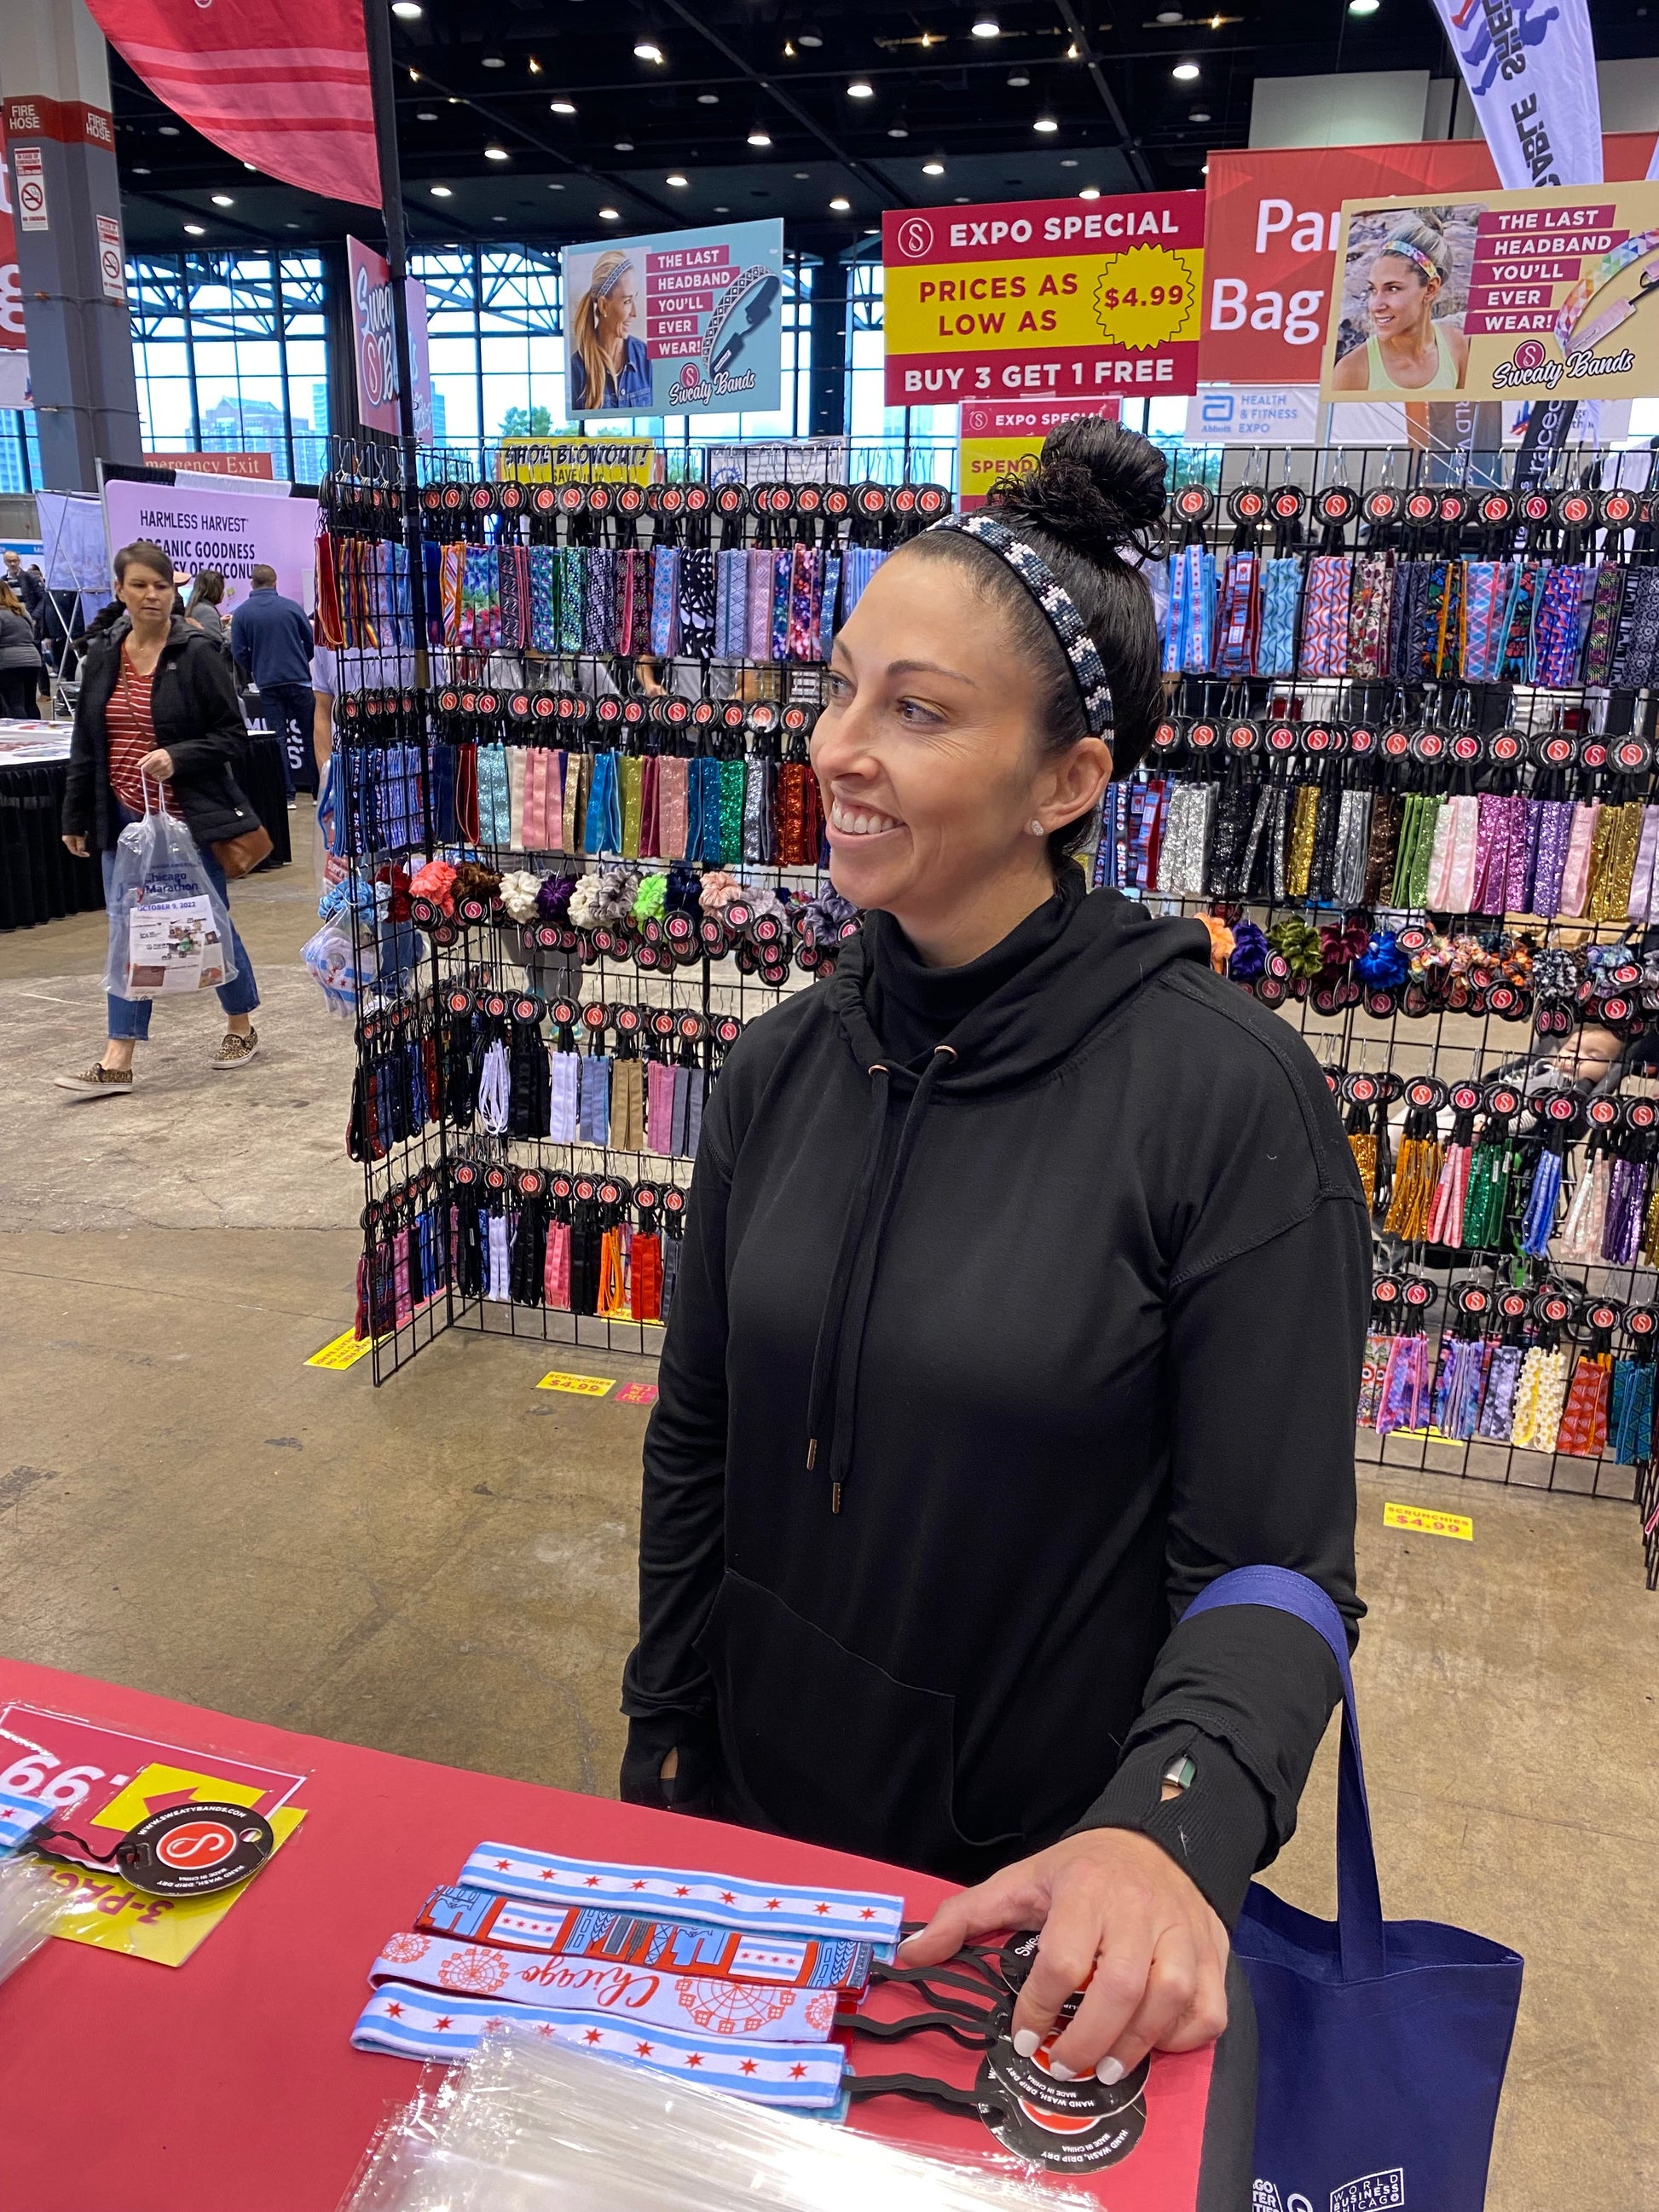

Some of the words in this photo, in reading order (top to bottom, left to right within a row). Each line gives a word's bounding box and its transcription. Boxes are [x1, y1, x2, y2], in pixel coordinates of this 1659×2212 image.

[11, 105, 36, 118] FIRE
[9, 116, 41, 130] HOSE
[87, 112, 107, 128] FIRE
[86, 123, 112, 142] HOSE
[1498, 213, 1538, 230] THE
[1545, 210, 1599, 228] LAST
[950, 220, 1032, 247] EXPO
[1044, 210, 1179, 241] SPECIAL
[1494, 235, 1612, 256] HEADBAND
[657, 254, 684, 269] THE
[685, 250, 720, 266] LAST
[658, 271, 731, 291] HEADBAND
[920, 275, 1026, 303] PRICES
[1038, 273, 1078, 297] AS
[1104, 284, 1183, 310] $4.99
[1487, 290, 1541, 306] EVER
[1209, 278, 1324, 346] Bag
[658, 320, 691, 334] EVER
[939, 312, 1006, 337] LOW
[1017, 309, 1057, 332] AS
[1485, 314, 1554, 331] WEAR!
[658, 339, 702, 355] WEAR!
[905, 367, 964, 392] BUY
[974, 367, 991, 389] 3
[1002, 364, 1061, 387] GET
[1072, 362, 1083, 384] 1
[1095, 359, 1174, 384] FREE
[1493, 361, 1563, 390] Sweaty
[1567, 349, 1635, 378] Bands
[669, 378, 712, 406] Sweaty
[713, 369, 755, 396] Bands
[1241, 396, 1286, 405] HEALTH
[995, 414, 1037, 426] EXPO
[1240, 409, 1247, 419] &
[1251, 409, 1298, 419] FITNESS
[1201, 424, 1231, 433] Abbott
[1238, 423, 1269, 433] EXPO
[145, 459, 219, 474] mergency
[227, 457, 260, 474] Exit
[971, 459, 1033, 474] SPEND
[552, 469, 578, 483] SAVE
[140, 510, 198, 530] HARMLESS
[201, 515, 246, 533] HARVEST
[195, 541, 255, 559] GOODNESS
[145, 880, 199, 893] Marathon
[548, 1373, 612, 1386] SCRUNCHIES
[549, 1379, 600, 1392] $4.99
[1388, 1506, 1469, 1527] SCRUNCHIES
[1396, 1515, 1460, 1533] $4.99
[137, 1805, 246, 1835] WWW.SWEATYBANDS.COM
[208, 1868, 227, 1877] MADE
[223, 1864, 245, 1878] HAND
[195, 1875, 223, 1887] WASH,
[44, 1868, 176, 1926] 3-PAC
[514, 1955, 660, 2008] Chicago
[1005, 2065, 1021, 2082] DRY
[1018, 2080, 1038, 2095] DRIP
[1026, 2075, 1047, 2091] CHINA
[1038, 2091, 1066, 2106] WASH,
[1068, 2099, 1095, 2108] HAND
[1092, 2133, 1111, 2146] MADE
[1110, 2128, 1128, 2150] HAND
[1040, 2150, 1061, 2161] DRY
[1061, 2144, 1085, 2153] CHINA
[1084, 2146, 1113, 2161] WASH,
[1061, 2154, 1084, 2163] DRIP
[1334, 2174, 1398, 2202] WORLD
[1333, 2183, 1400, 2212] BUSINESS
